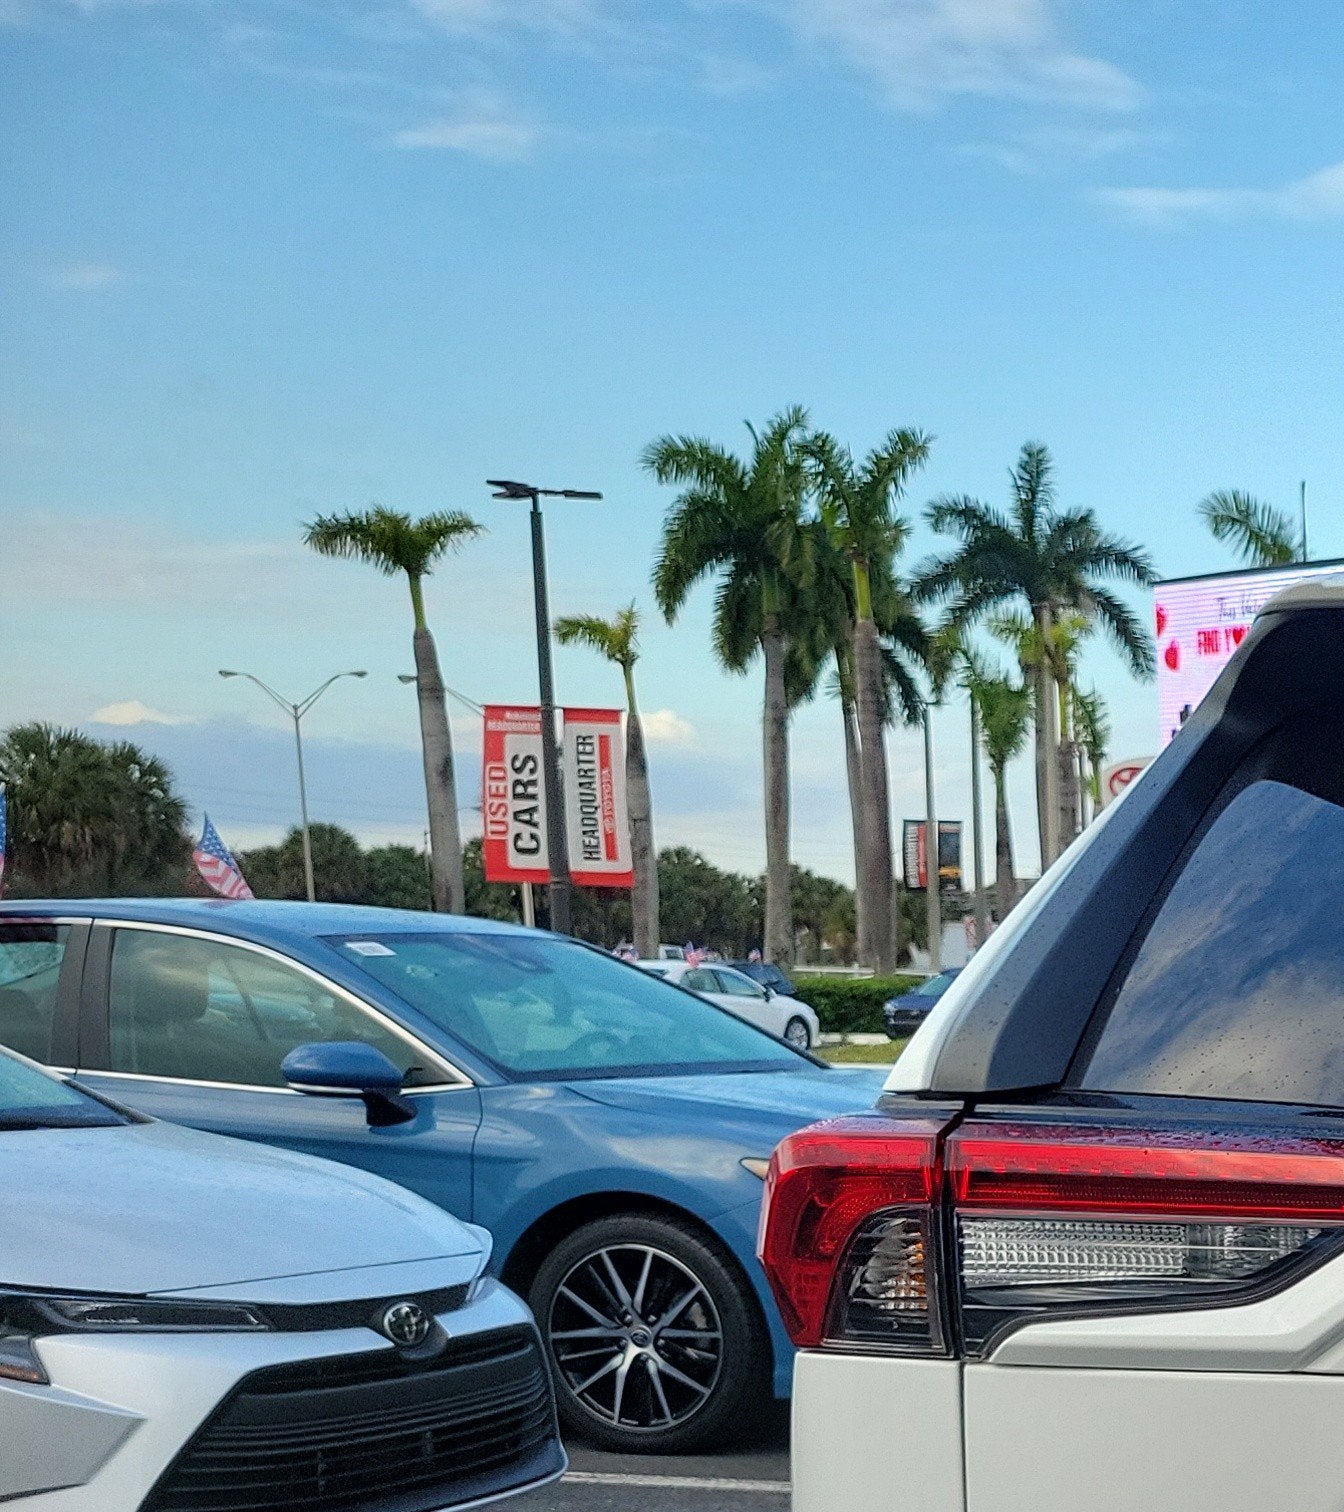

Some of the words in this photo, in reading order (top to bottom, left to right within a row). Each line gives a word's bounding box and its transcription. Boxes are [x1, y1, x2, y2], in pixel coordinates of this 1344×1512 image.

[488, 764, 509, 837] USED
[511, 753, 542, 857] CARS
[575, 734, 602, 862] HEADQUARTER
